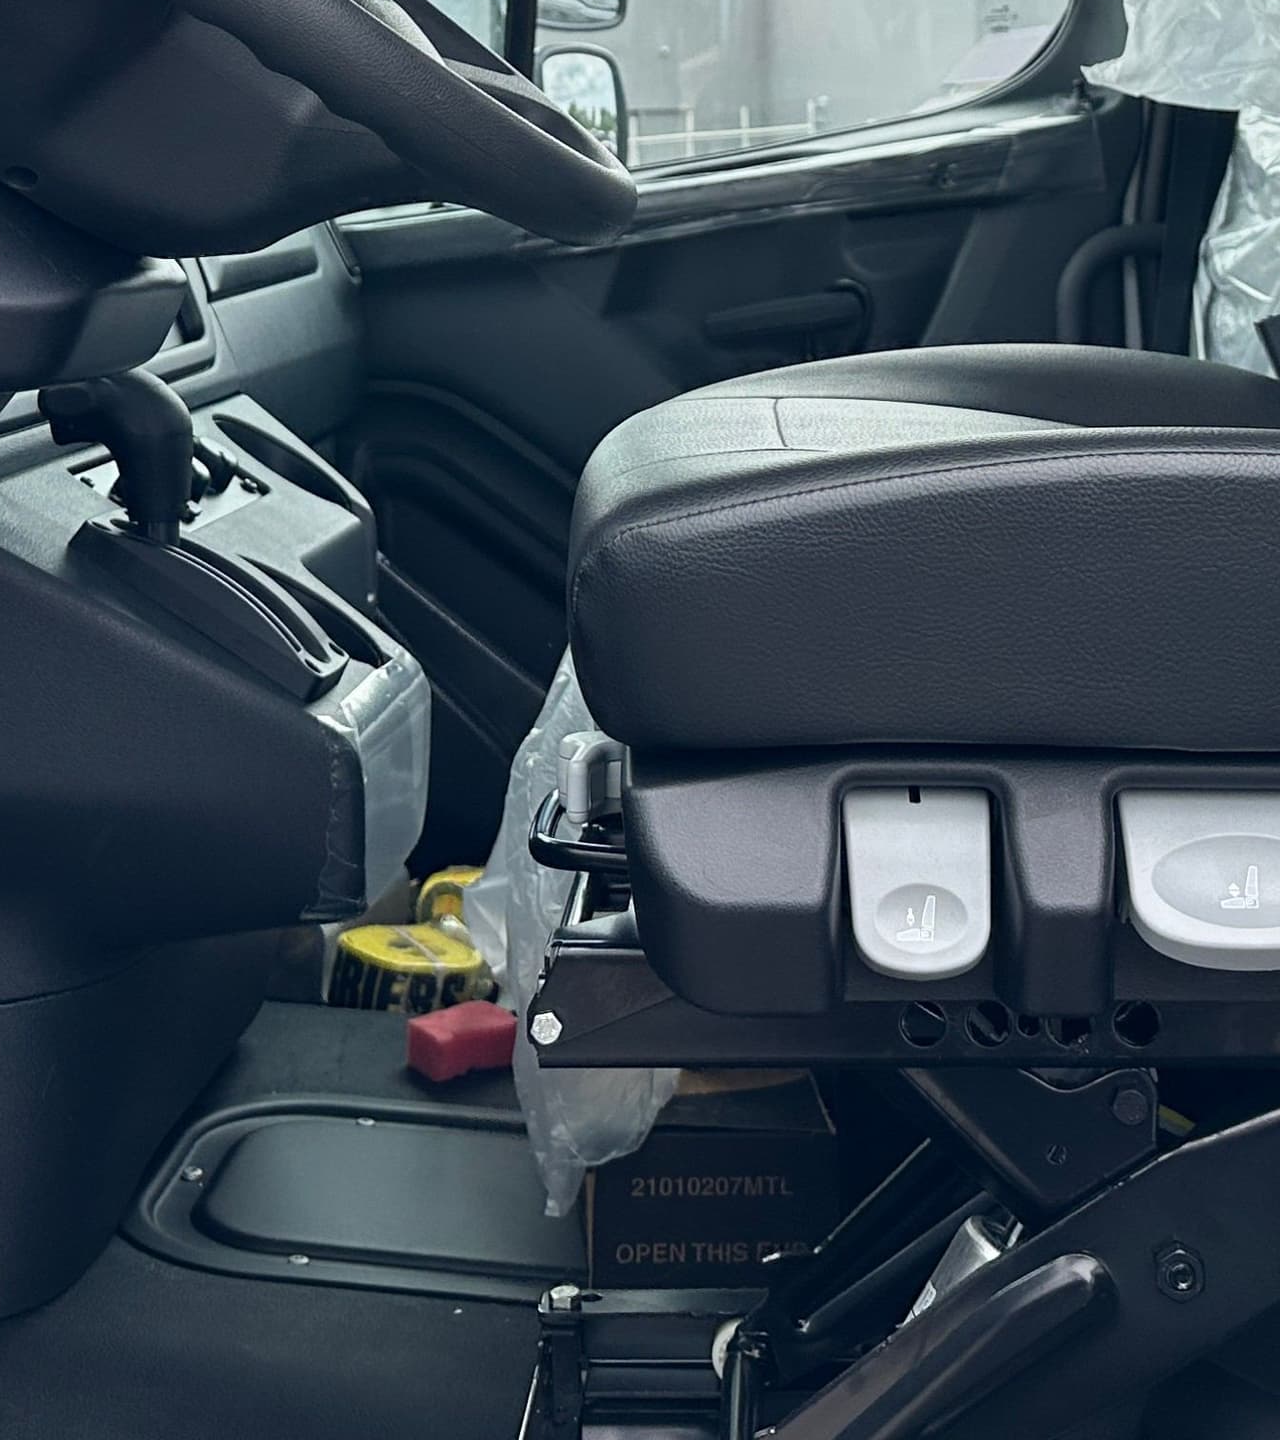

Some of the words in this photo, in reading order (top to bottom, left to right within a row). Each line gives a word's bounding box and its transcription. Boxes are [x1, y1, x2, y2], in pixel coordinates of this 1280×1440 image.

[631, 1175, 794, 1197] 21010207MTL
[616, 1242, 686, 1263] OPEN
[691, 1242, 749, 1263] THIS
